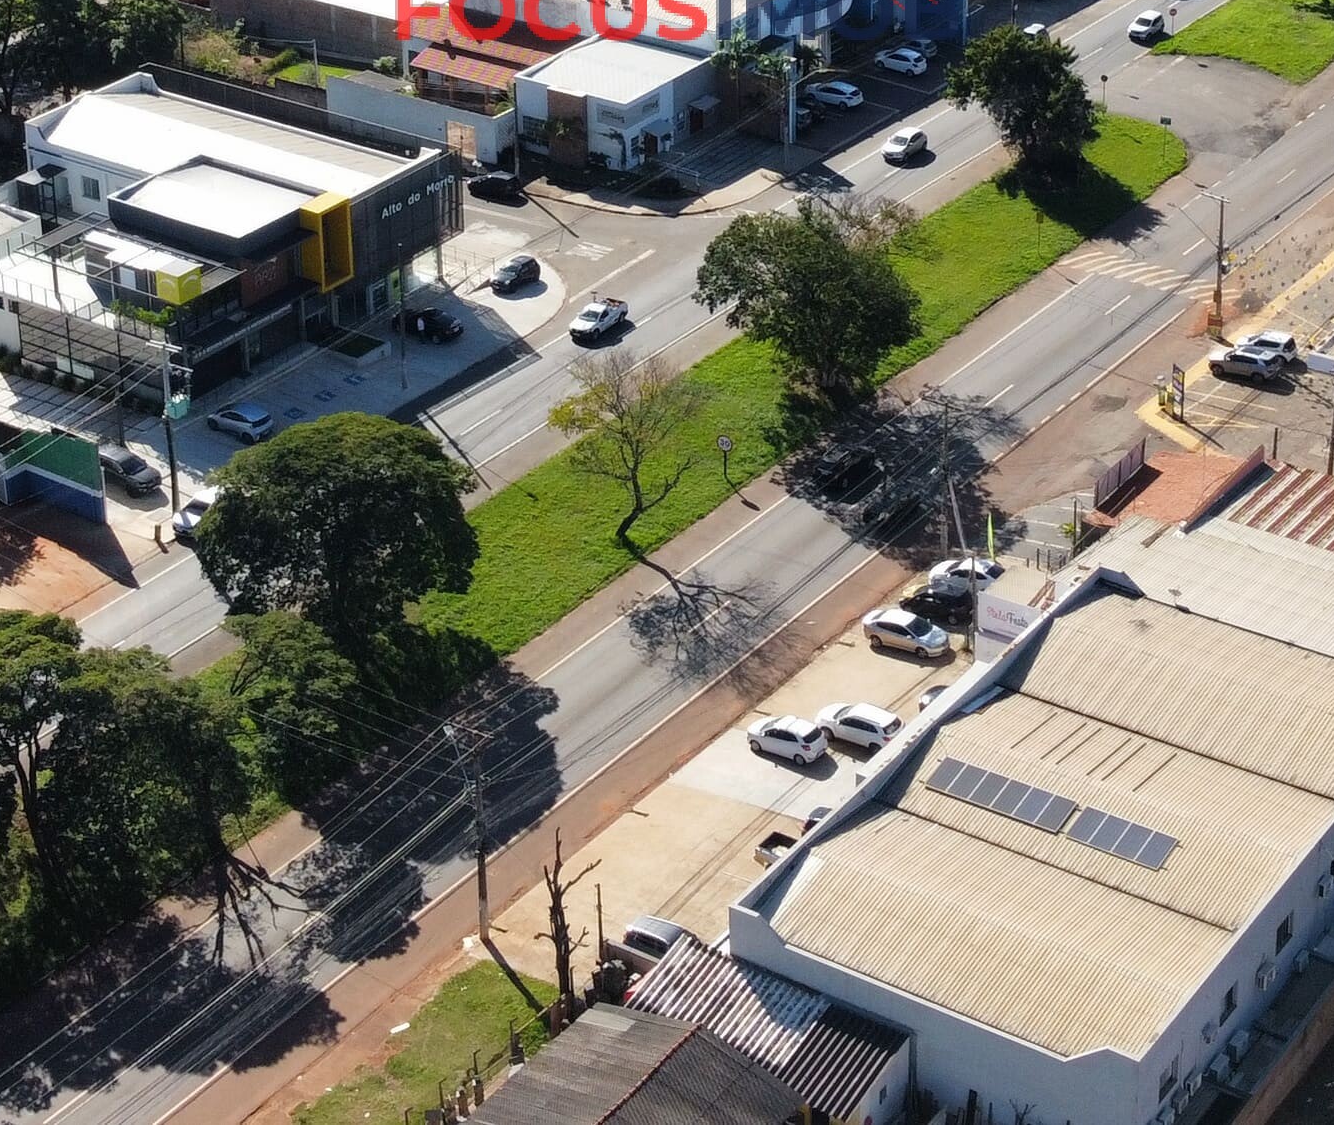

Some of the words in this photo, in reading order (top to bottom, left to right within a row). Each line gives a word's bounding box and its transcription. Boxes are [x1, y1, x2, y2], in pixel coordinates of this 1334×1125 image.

[381, 202, 403, 219] Alto
[407, 193, 421, 206] do
[427, 175, 454, 195] Morro
